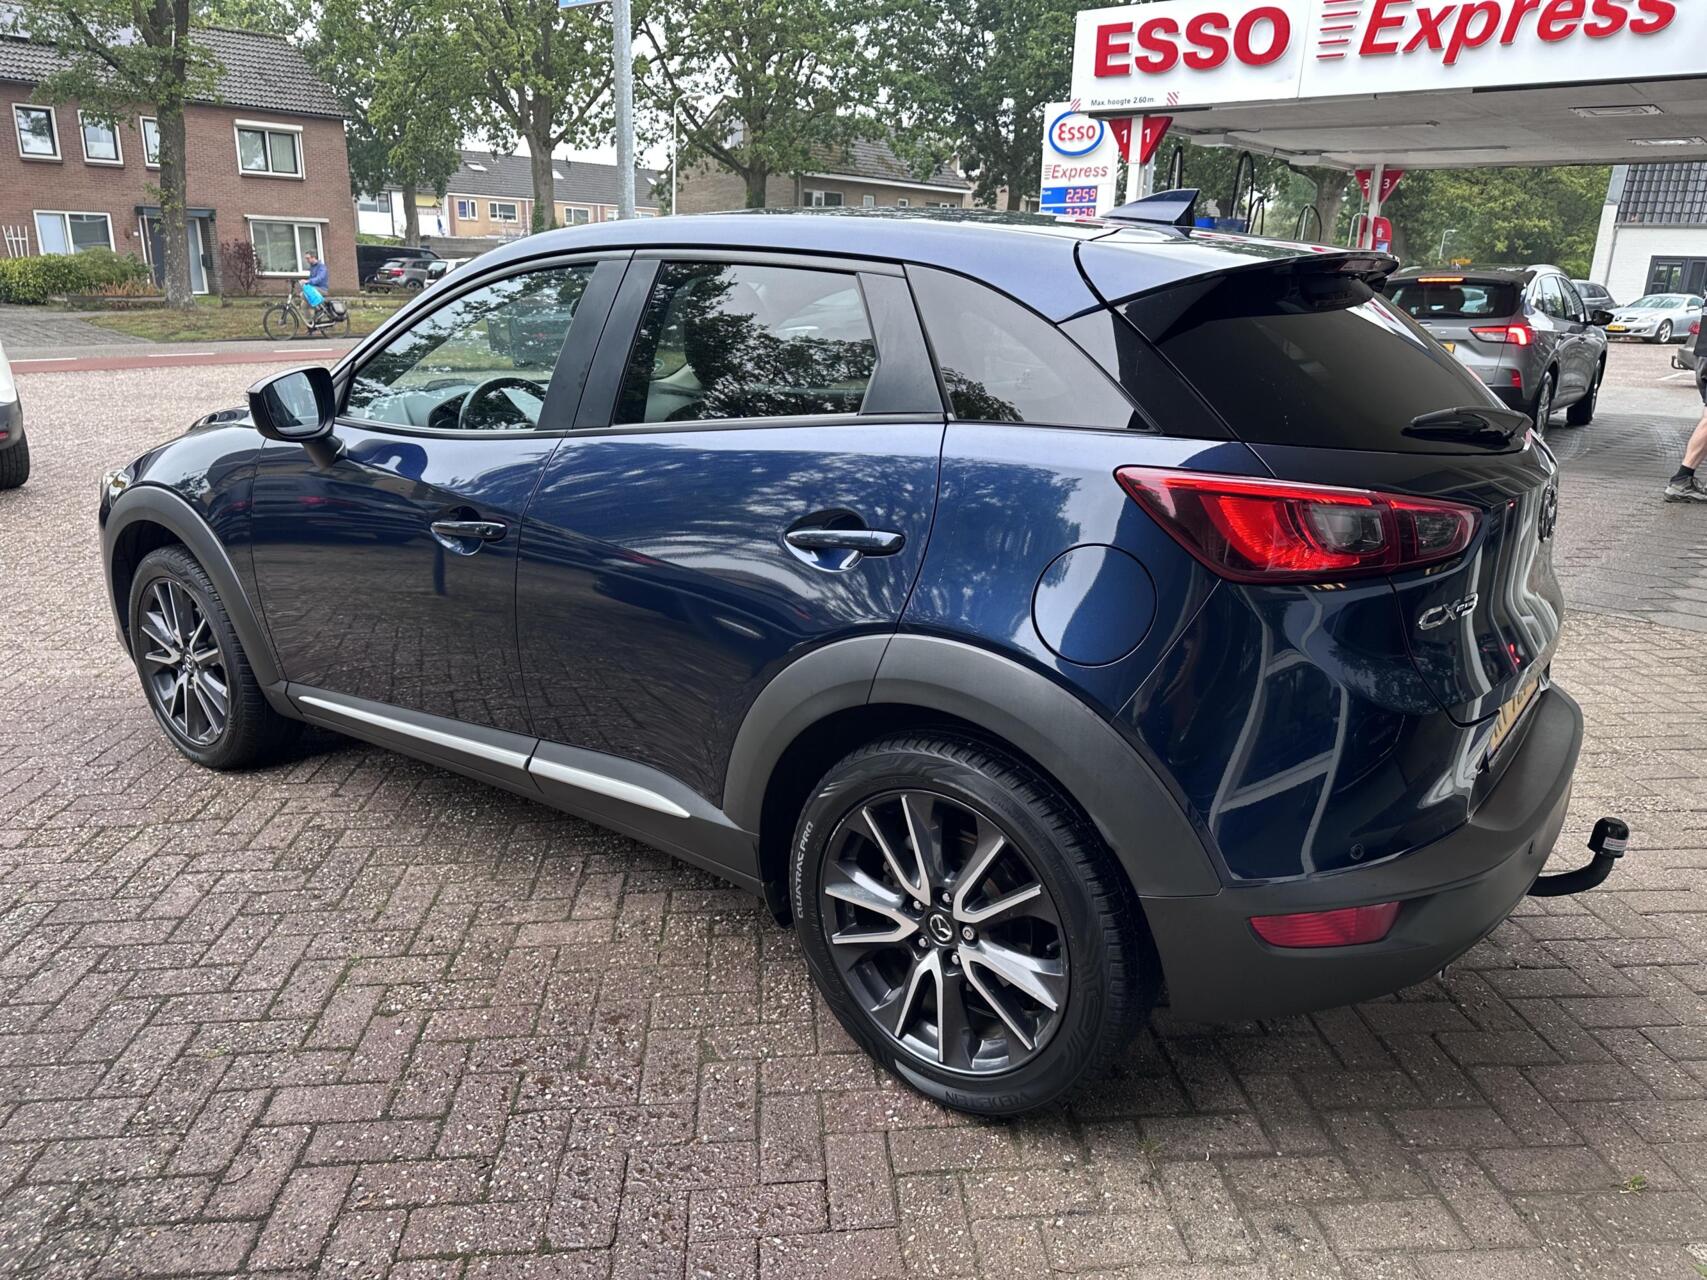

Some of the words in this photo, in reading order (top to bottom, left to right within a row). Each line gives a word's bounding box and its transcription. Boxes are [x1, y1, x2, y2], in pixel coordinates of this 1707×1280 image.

[1094, 6, 1291, 77] ESSO
[1359, 0, 1678, 65] Express
[1107, 97, 1131, 106] hoogte
[1058, 122, 1096, 141] Esso
[1121, 129, 1128, 144] 1
[1144, 128, 1151, 143] 1
[1051, 164, 1109, 182] Express
[1363, 179, 1370, 189] 3
[1383, 178, 1390, 189] 3
[1418, 592, 1478, 630] CX-3
[800, 821, 814, 852] PRO
